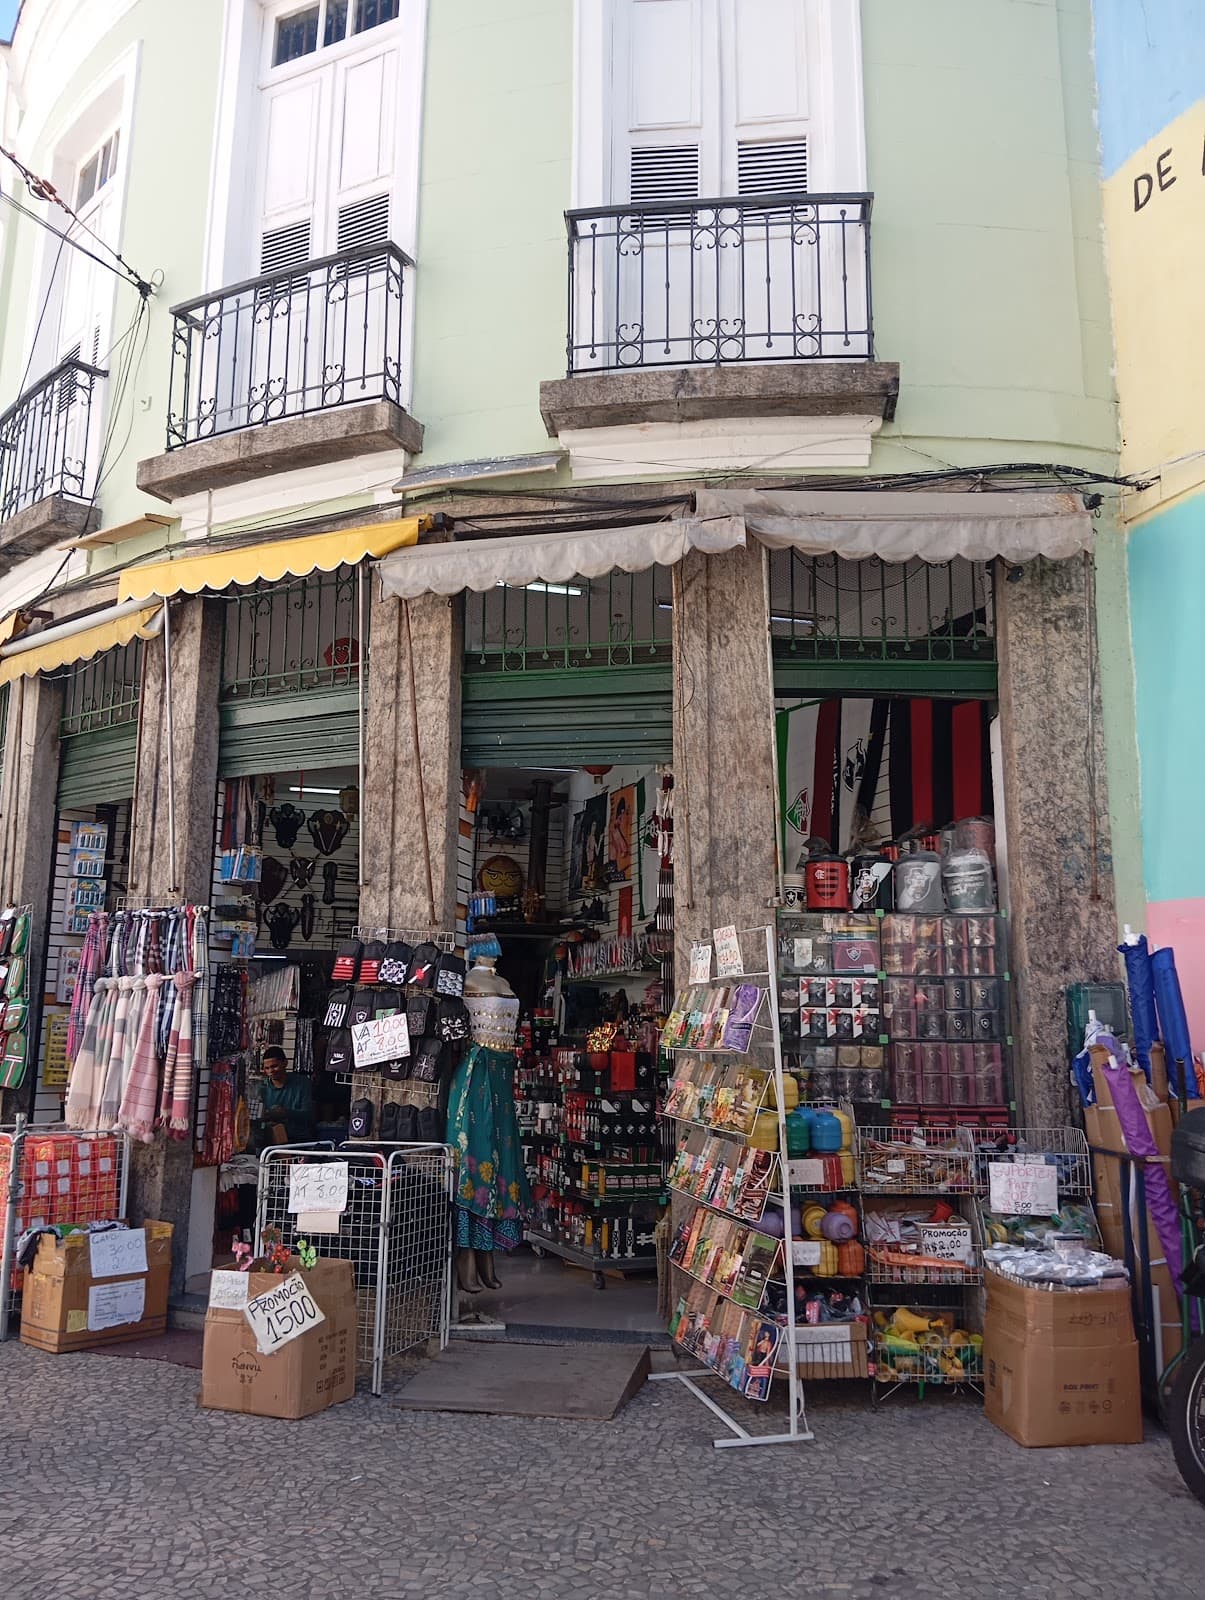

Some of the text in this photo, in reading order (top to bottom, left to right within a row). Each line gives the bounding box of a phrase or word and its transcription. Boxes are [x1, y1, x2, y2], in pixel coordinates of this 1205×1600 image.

[1134, 148, 1177, 213] DE
[353, 1022, 371, 1041] VA
[357, 1038, 371, 1054] AT
[293, 1183, 309, 1200] AT
[922, 1228, 968, 1240] PROMOÇÃO
